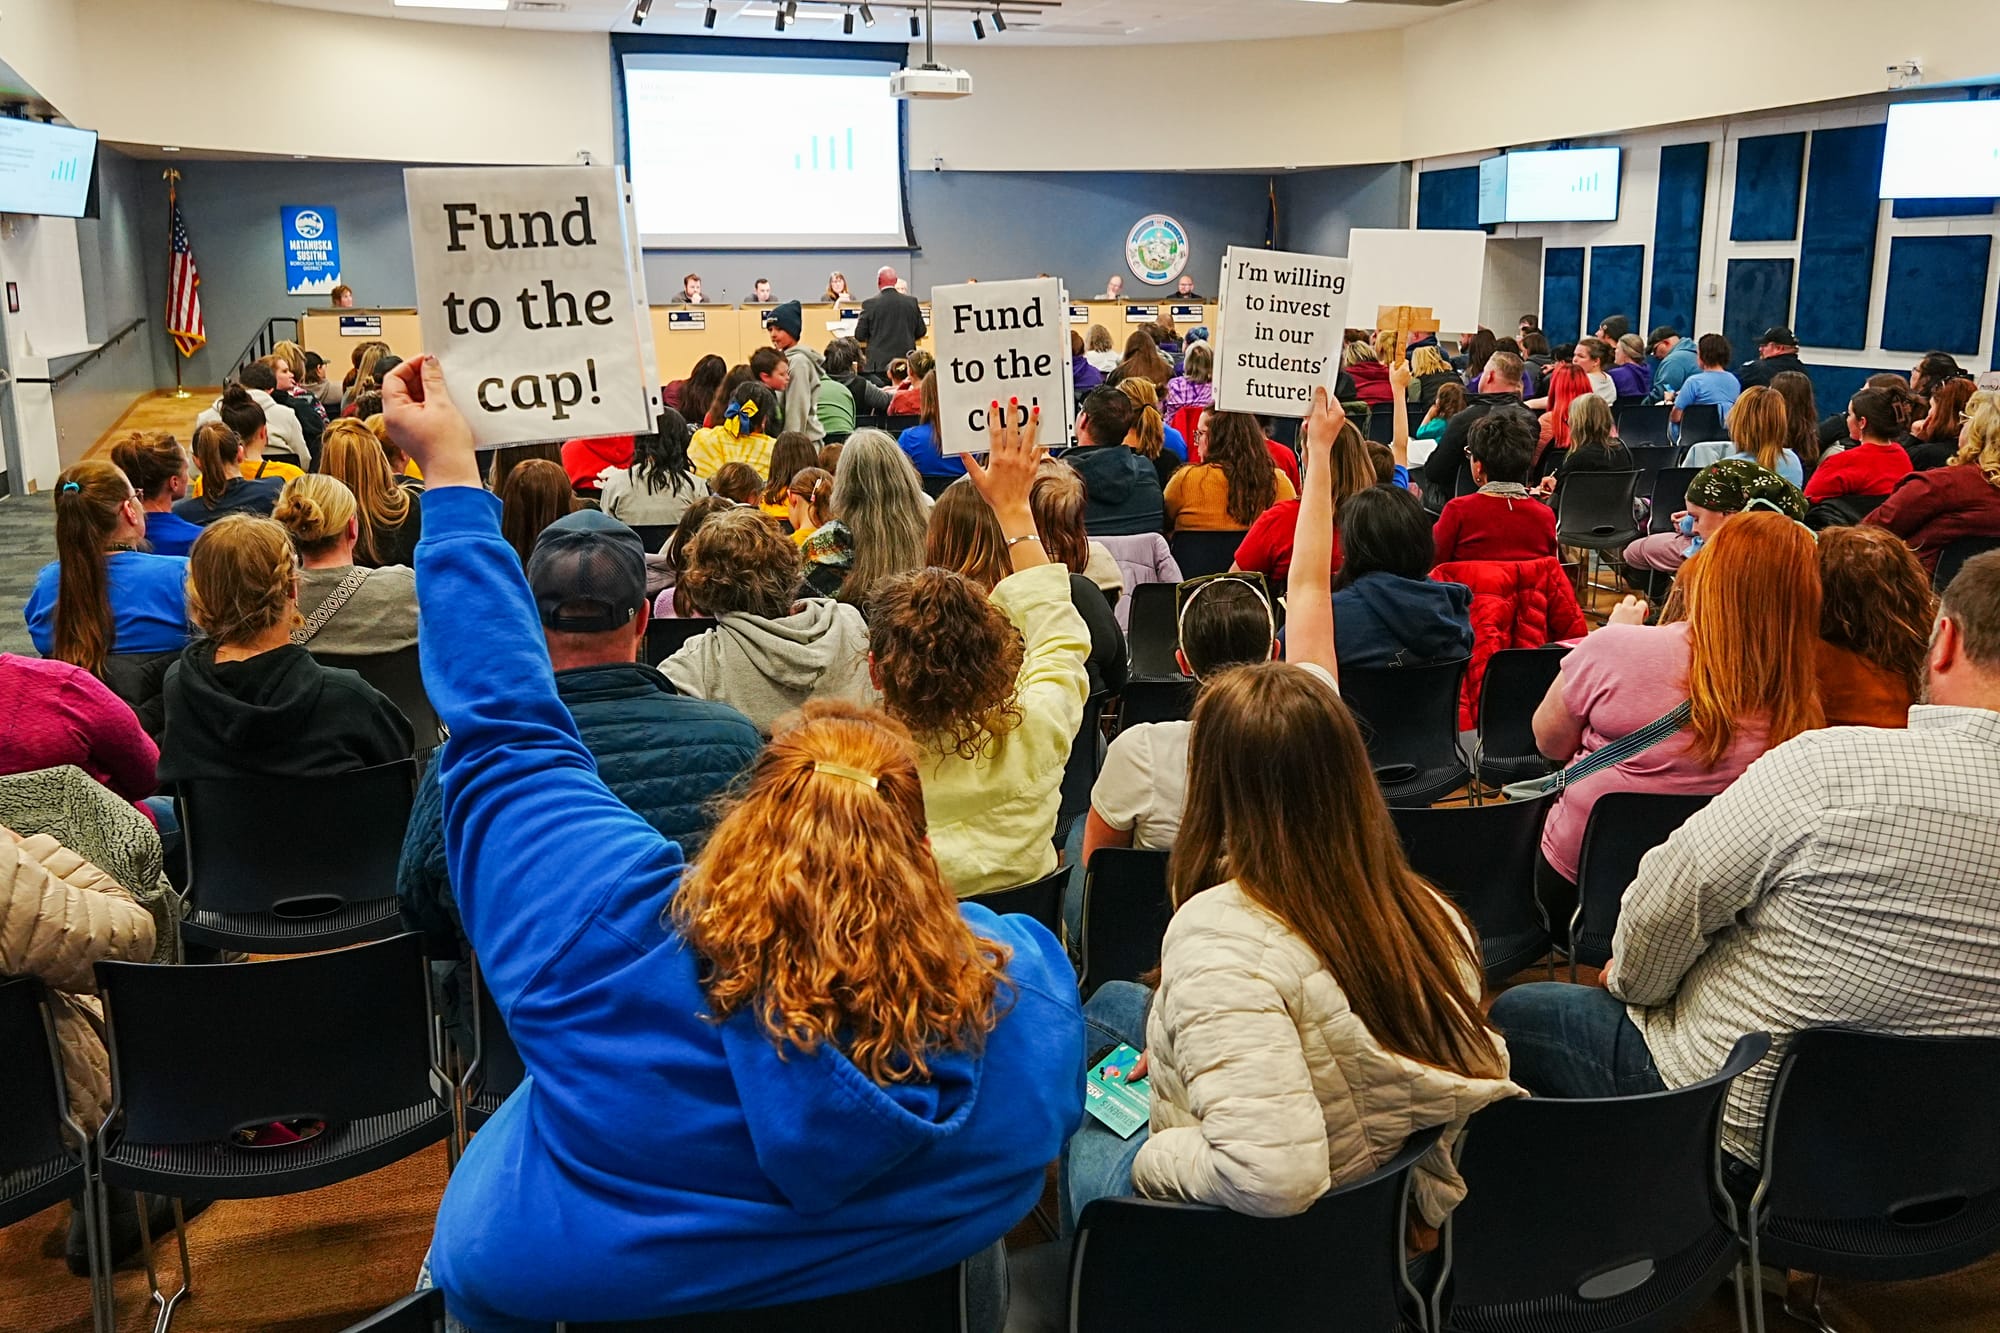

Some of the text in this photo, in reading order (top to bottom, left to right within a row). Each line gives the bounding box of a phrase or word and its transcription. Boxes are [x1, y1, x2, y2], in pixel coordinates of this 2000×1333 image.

[443, 197, 597, 252] Fund
[289, 239, 332, 251] MATANUSKA
[1238, 262, 1345, 294] I'm willing
[443, 280, 613, 335] to the
[953, 297, 1044, 333] Fund
[1246, 294, 1331, 317] to invest
[1254, 322, 1314, 345] in our
[951, 349, 1052, 384] to the
[1237, 352, 1328, 374] students'
[477, 359, 601, 421] cap!
[1246, 379, 1312, 401] future!
